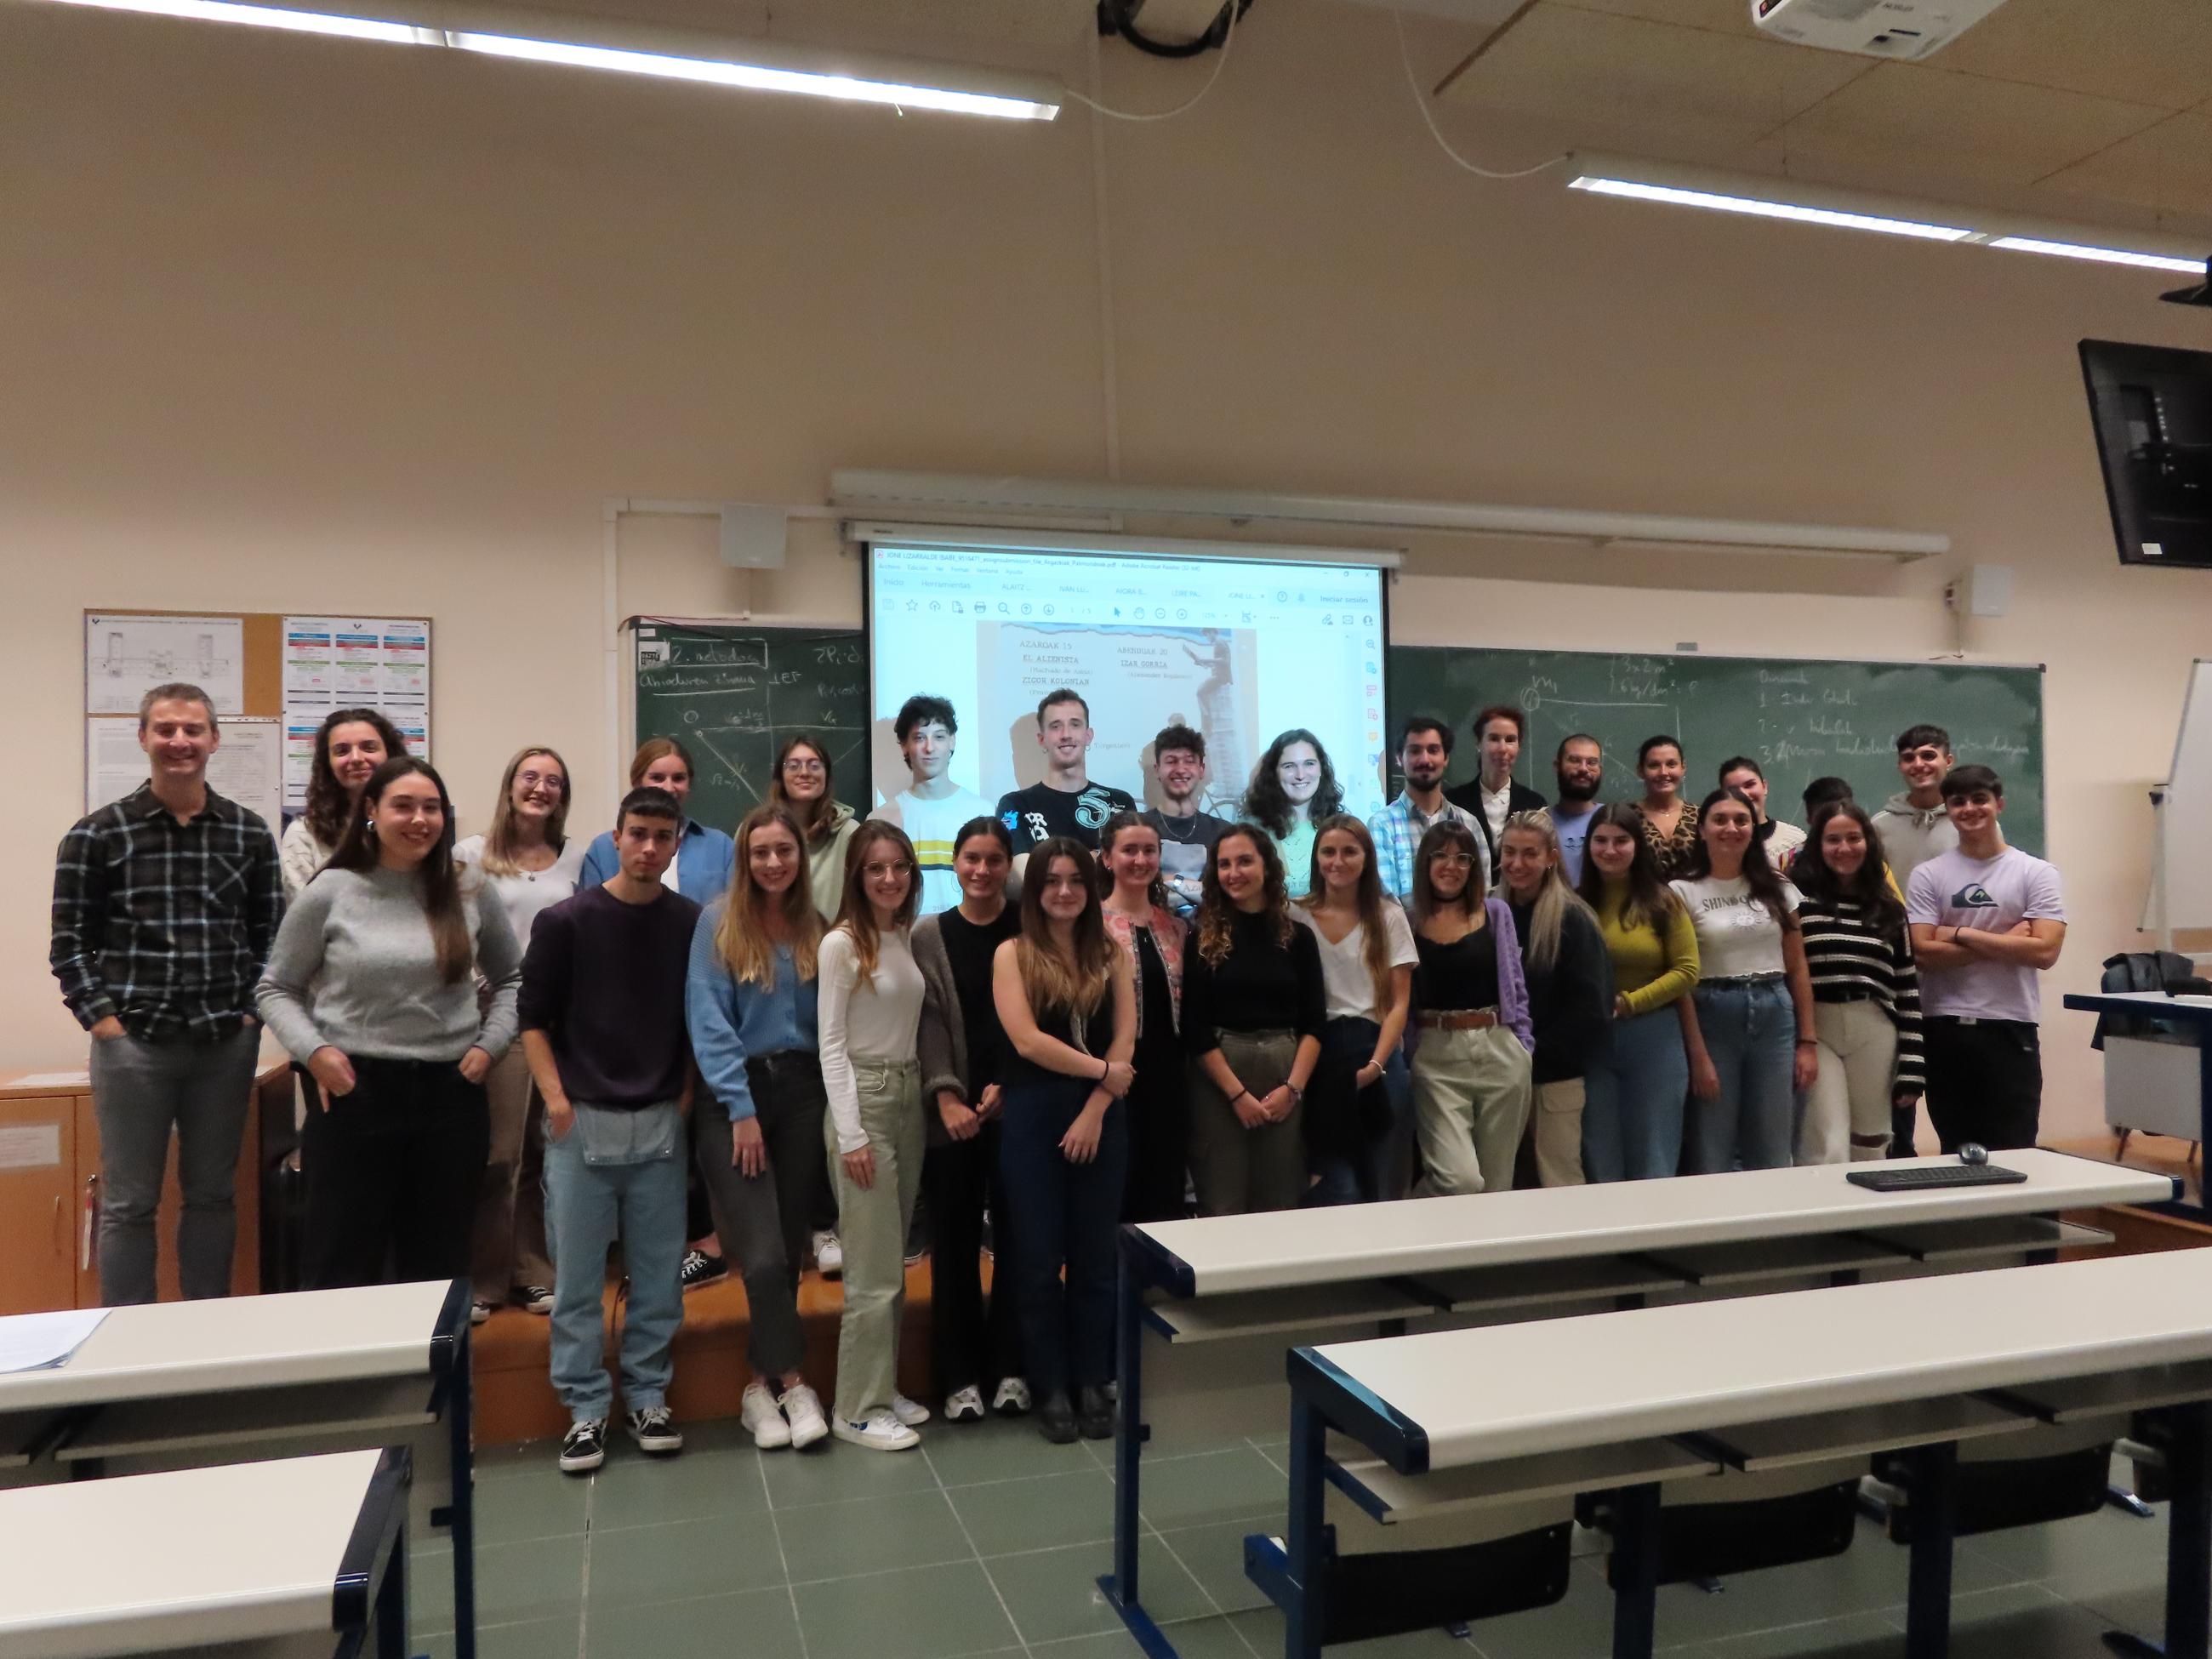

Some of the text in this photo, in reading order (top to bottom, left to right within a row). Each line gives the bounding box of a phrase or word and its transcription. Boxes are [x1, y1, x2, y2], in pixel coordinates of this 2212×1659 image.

[883, 578, 971, 590] Inicio Herramientas
[1320, 595, 1369, 605] Iniciar sesión
[1019, 640, 1059, 649] AZAROAK
[1116, 646, 1157, 655] ABENDUAK
[1036, 655, 1079, 664] ALIENISTA
[1120, 659, 1168, 669] IZAR GORRIA
[1022, 676, 1090, 686] ZIGOR KOLONIAN
